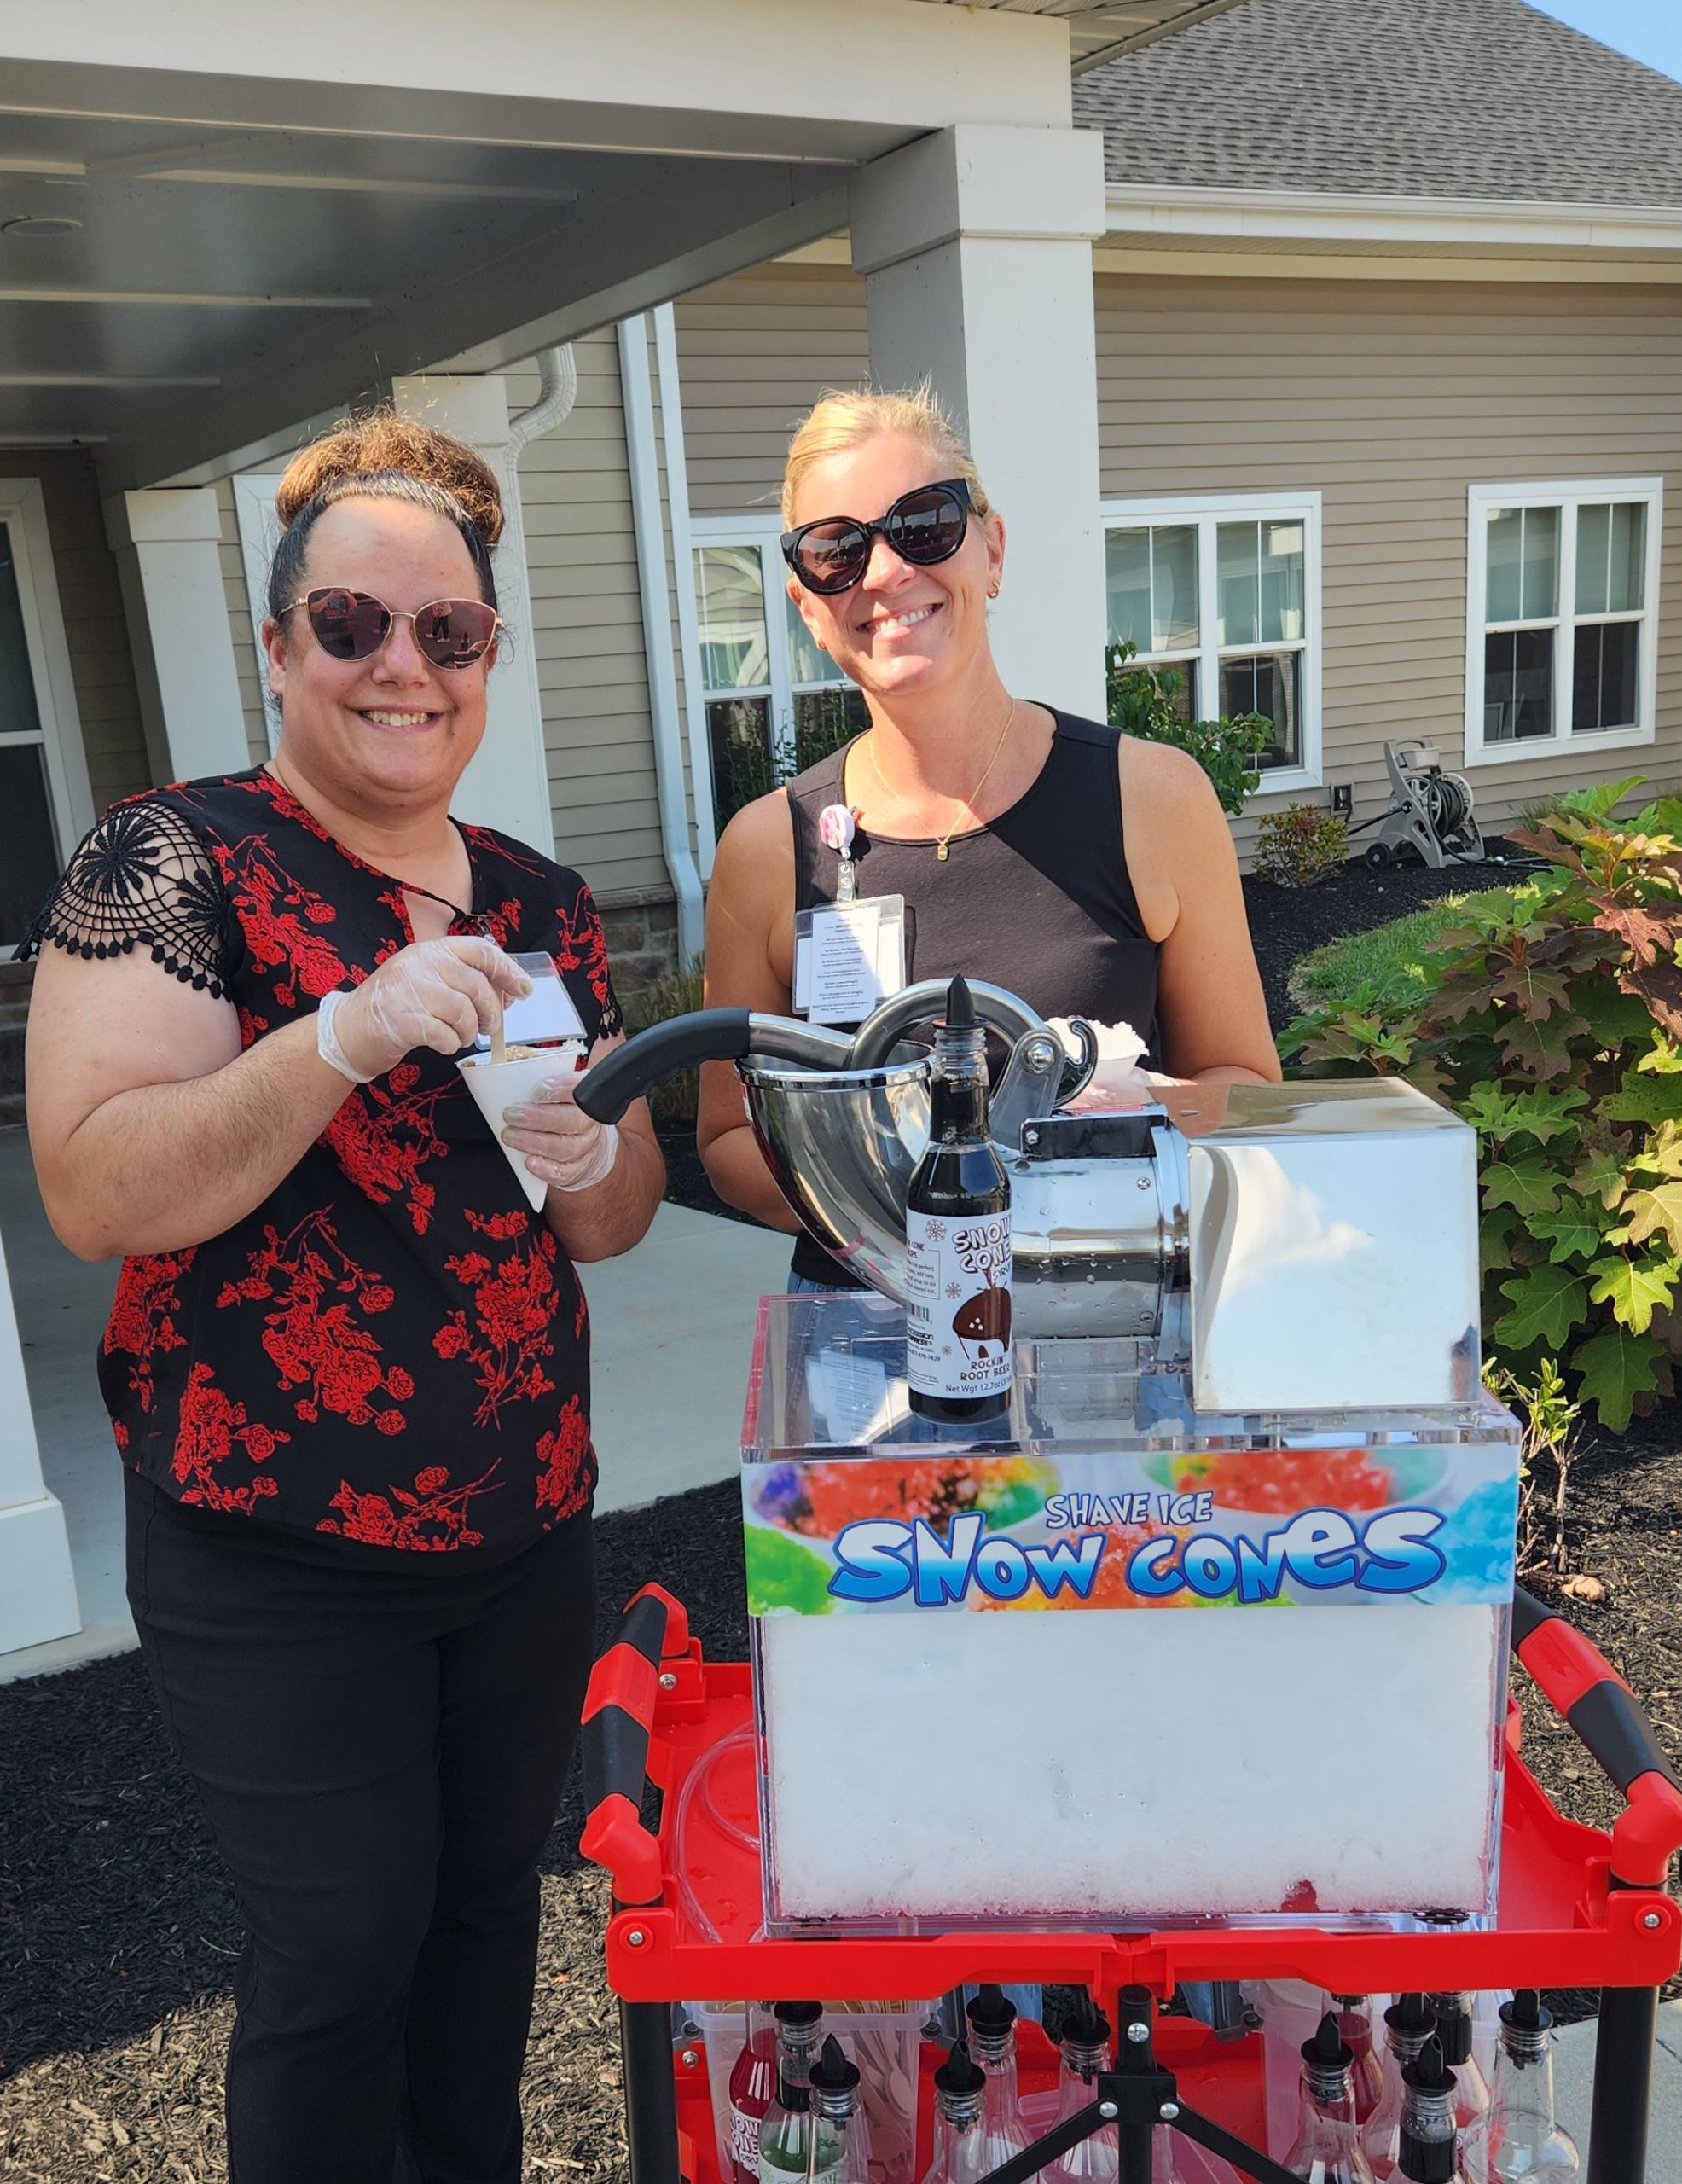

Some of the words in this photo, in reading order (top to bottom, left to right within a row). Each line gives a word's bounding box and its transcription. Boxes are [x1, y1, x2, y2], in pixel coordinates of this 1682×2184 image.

[952, 1215, 1012, 1254] SNOW
[960, 1240, 1012, 1273] CONE
[960, 1370, 989, 1381] ROOT
[961, 1384, 978, 1394] Wgt
[1044, 1493, 1150, 1528] SHAVE
[1157, 1490, 1214, 1526] ICE
[827, 1510, 1107, 1607] SNOW
[740, 2153, 758, 2164] SYRU
